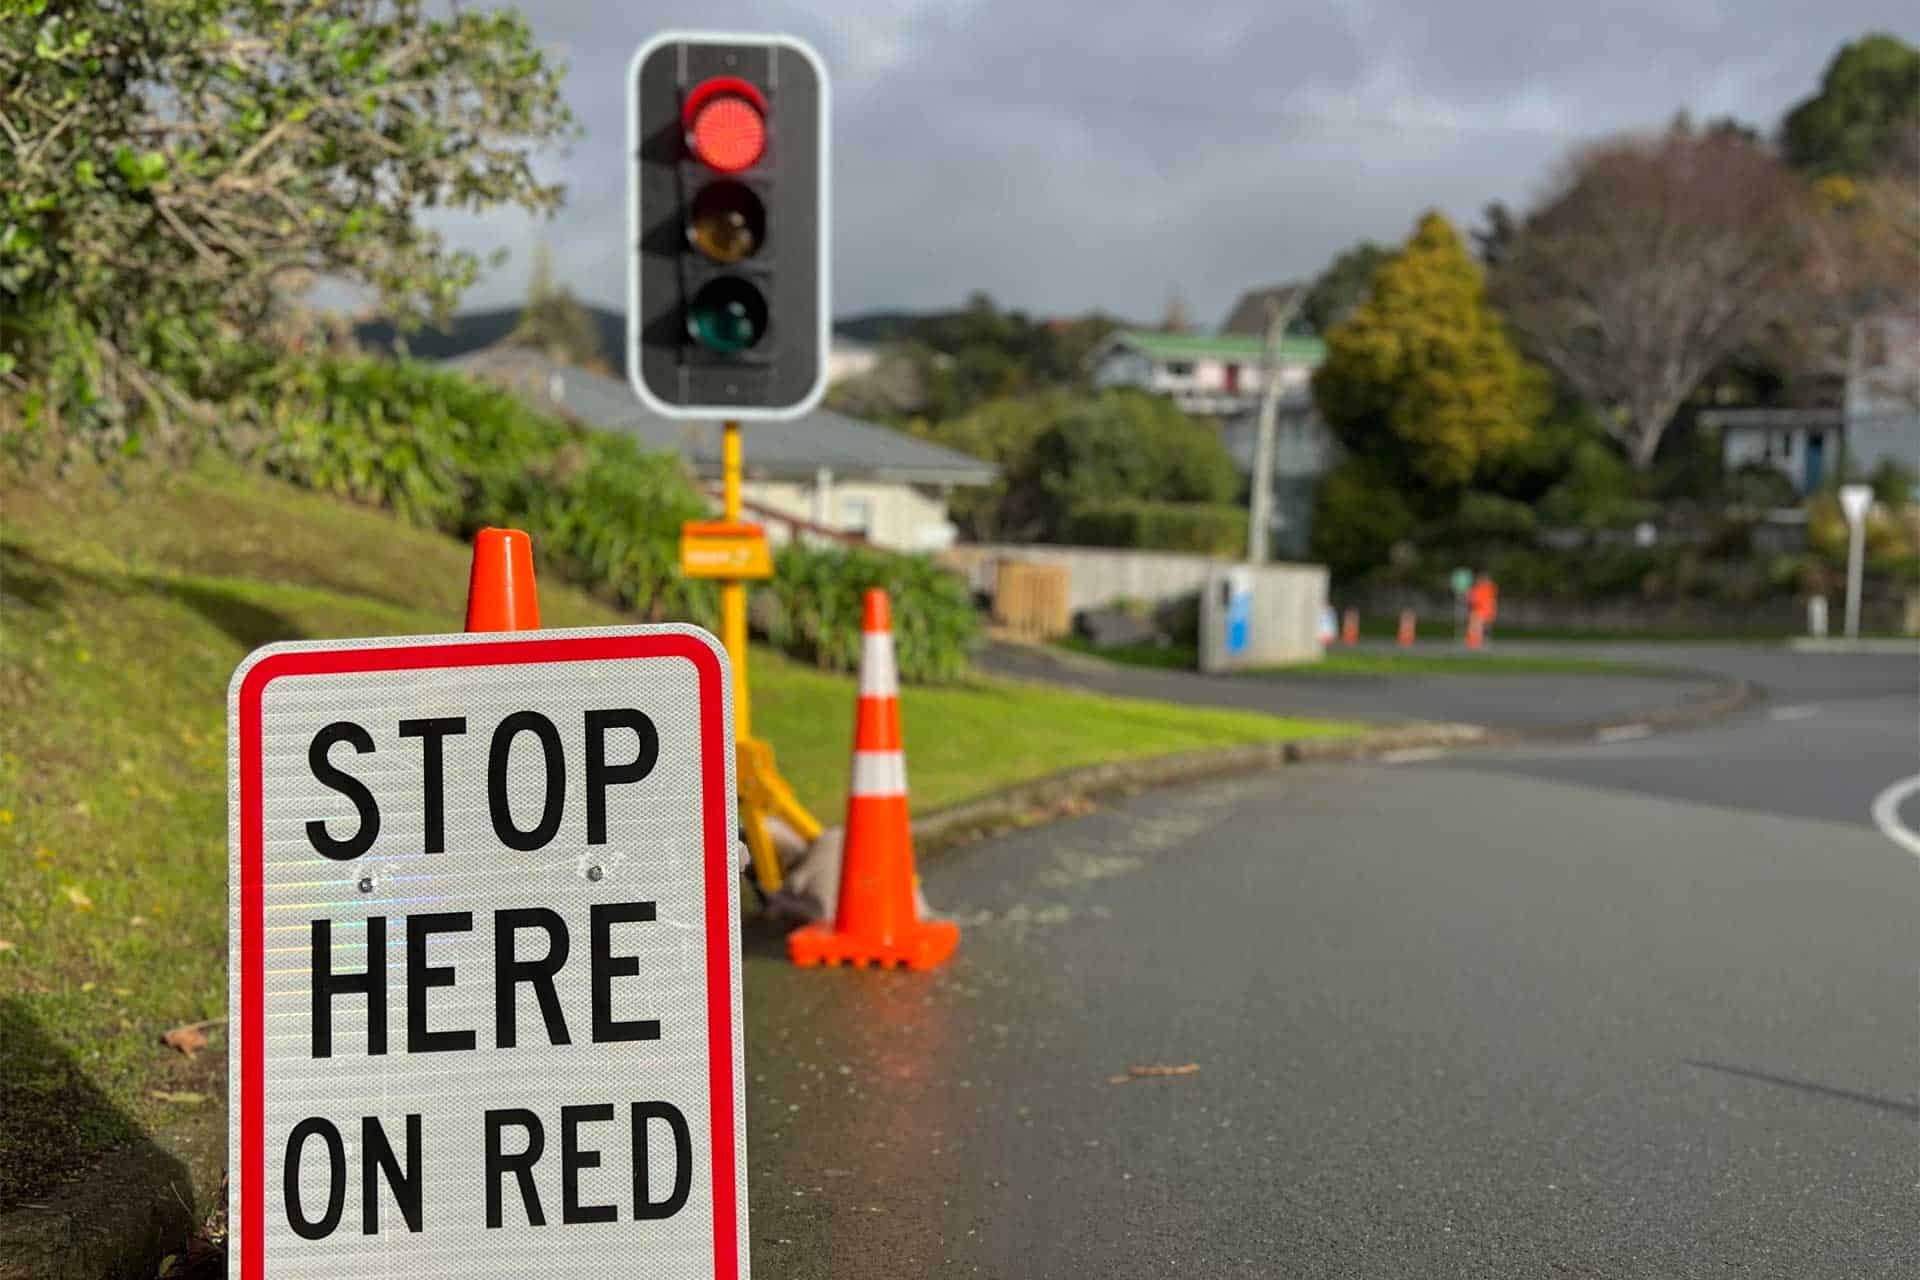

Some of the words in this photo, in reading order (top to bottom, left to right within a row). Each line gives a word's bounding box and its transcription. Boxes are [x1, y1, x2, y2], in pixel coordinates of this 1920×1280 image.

[306, 708, 660, 860] STOP
[311, 901, 661, 1058] HERE
[284, 1113, 423, 1241] ON
[484, 1100, 693, 1230] RED
